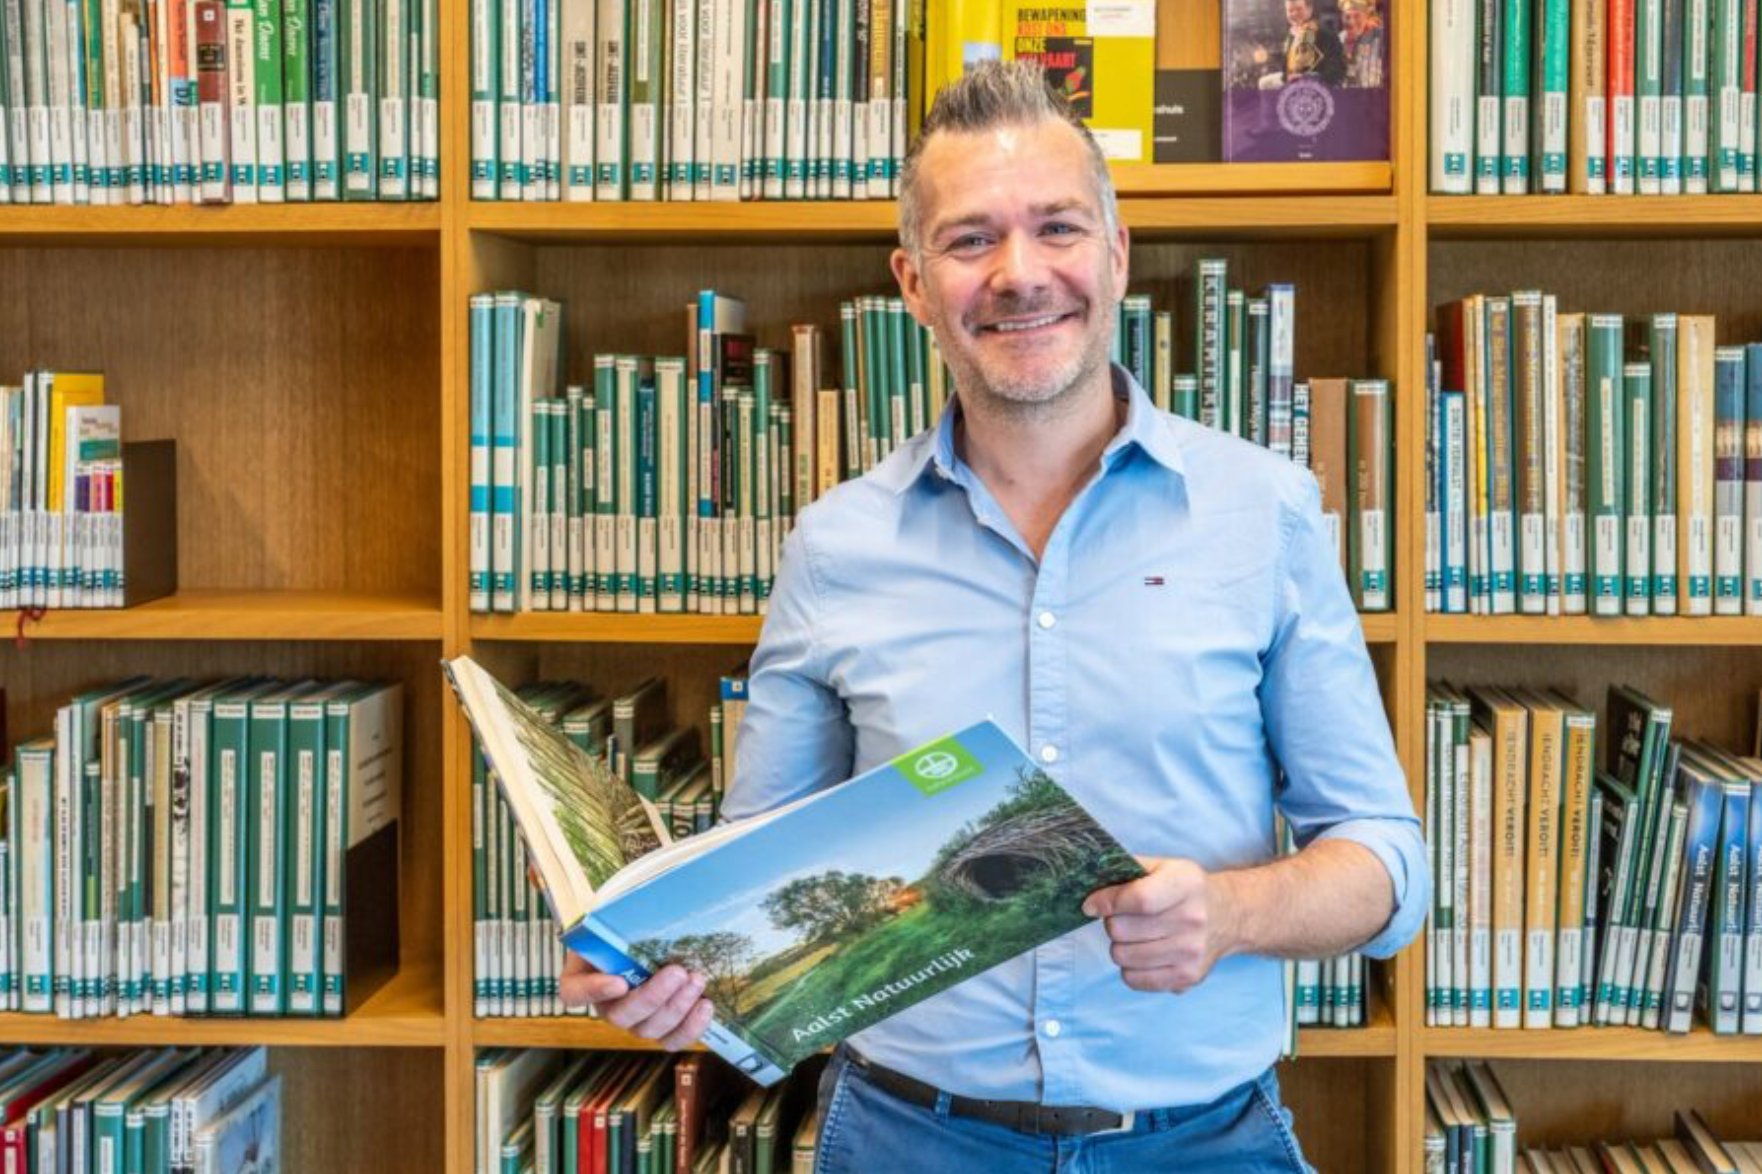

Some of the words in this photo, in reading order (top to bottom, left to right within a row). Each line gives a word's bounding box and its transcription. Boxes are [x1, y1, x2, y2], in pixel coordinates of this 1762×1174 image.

[1203, 275, 1219, 408] KERAMIEK
[1695, 844, 1708, 876] Aalst
[1729, 844, 1741, 876] Aalst
[792, 1006, 853, 1043] Aalst
[852, 946, 976, 1010] Natuurlijk
